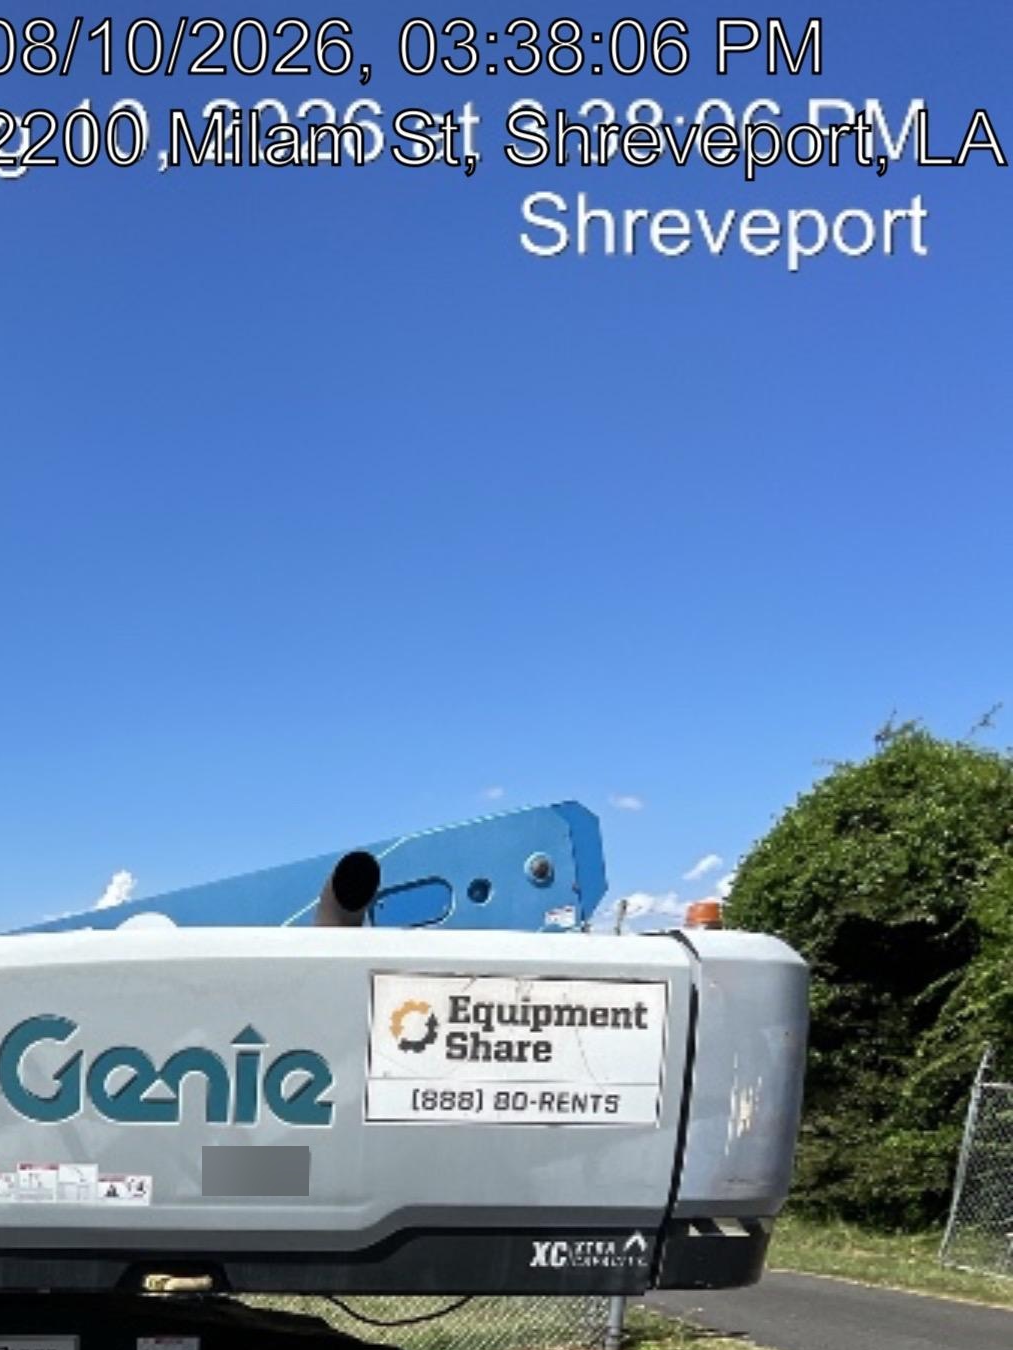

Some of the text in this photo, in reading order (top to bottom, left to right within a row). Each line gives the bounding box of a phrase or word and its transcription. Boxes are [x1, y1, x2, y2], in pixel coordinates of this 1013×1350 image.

[447, 995, 649, 1032] Equipment
[445, 1031, 553, 1063] Share
[493, 1091, 621, 1114] 80-RENTS
[529, 1241, 568, 1267] XC
